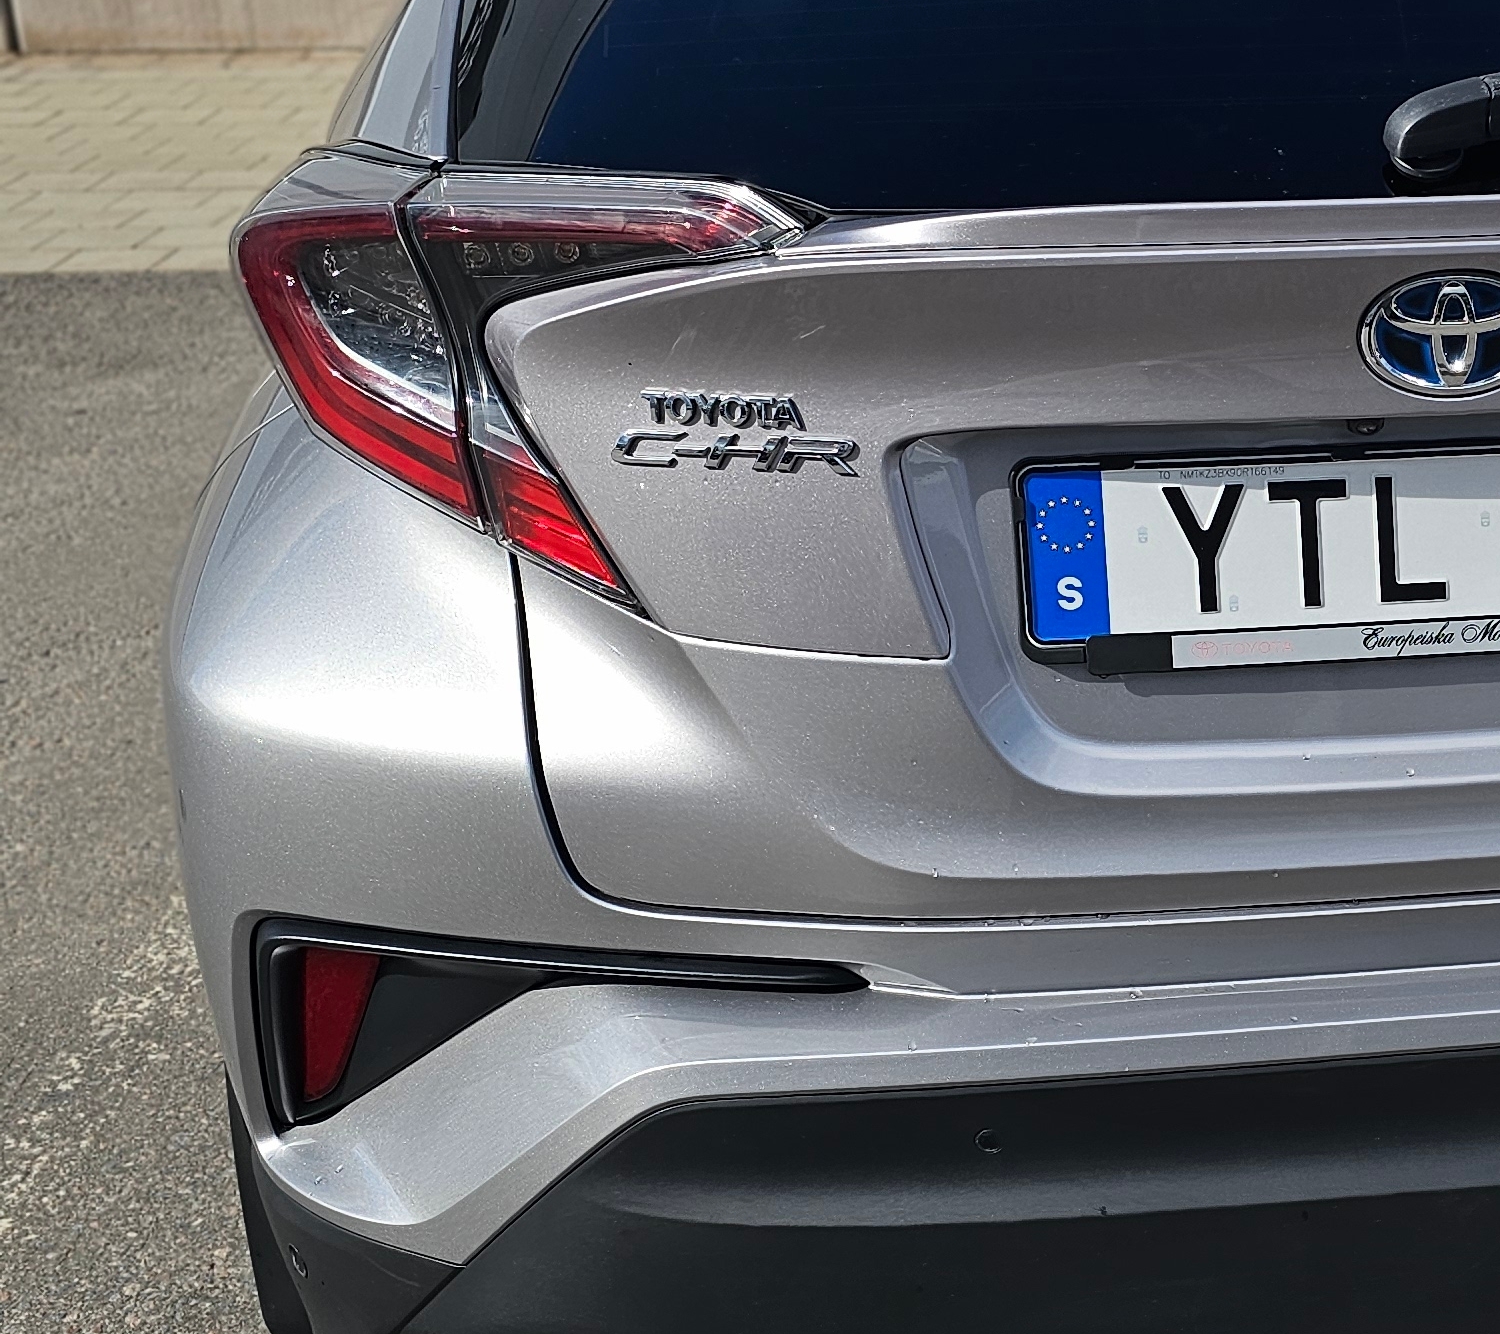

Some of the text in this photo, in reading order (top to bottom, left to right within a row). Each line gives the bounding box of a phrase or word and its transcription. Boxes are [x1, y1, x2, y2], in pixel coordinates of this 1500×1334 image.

[640, 387, 807, 431] TOYOTA
[610, 428, 861, 478] C-HR
[1161, 476, 1447, 613] YTL
[1056, 576, 1084, 610] S
[1221, 641, 1294, 656] TOYOTA
[1361, 621, 1455, 657] Europeiska
